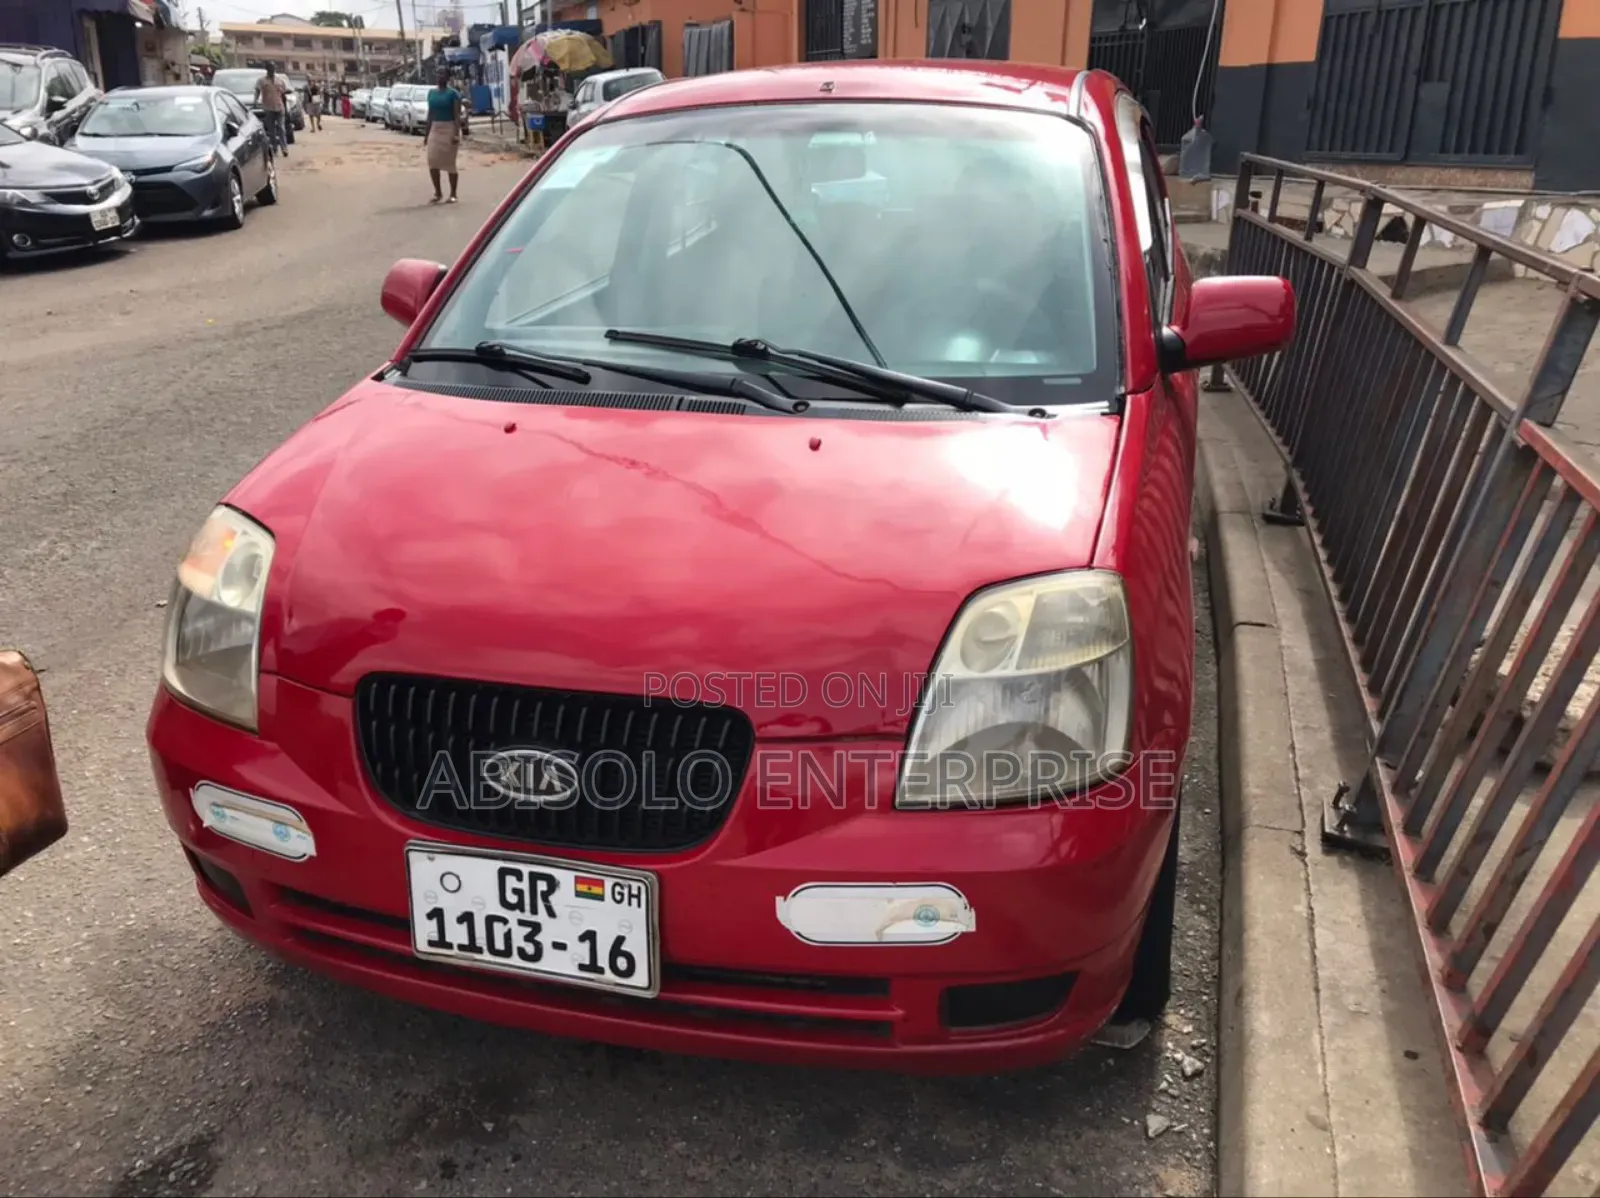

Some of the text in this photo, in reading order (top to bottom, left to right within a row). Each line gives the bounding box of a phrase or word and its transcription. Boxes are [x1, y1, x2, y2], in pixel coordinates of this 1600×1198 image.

[497, 866, 558, 919] GR
[611, 881, 642, 908] GH
[425, 906, 636, 978] 1103-16
